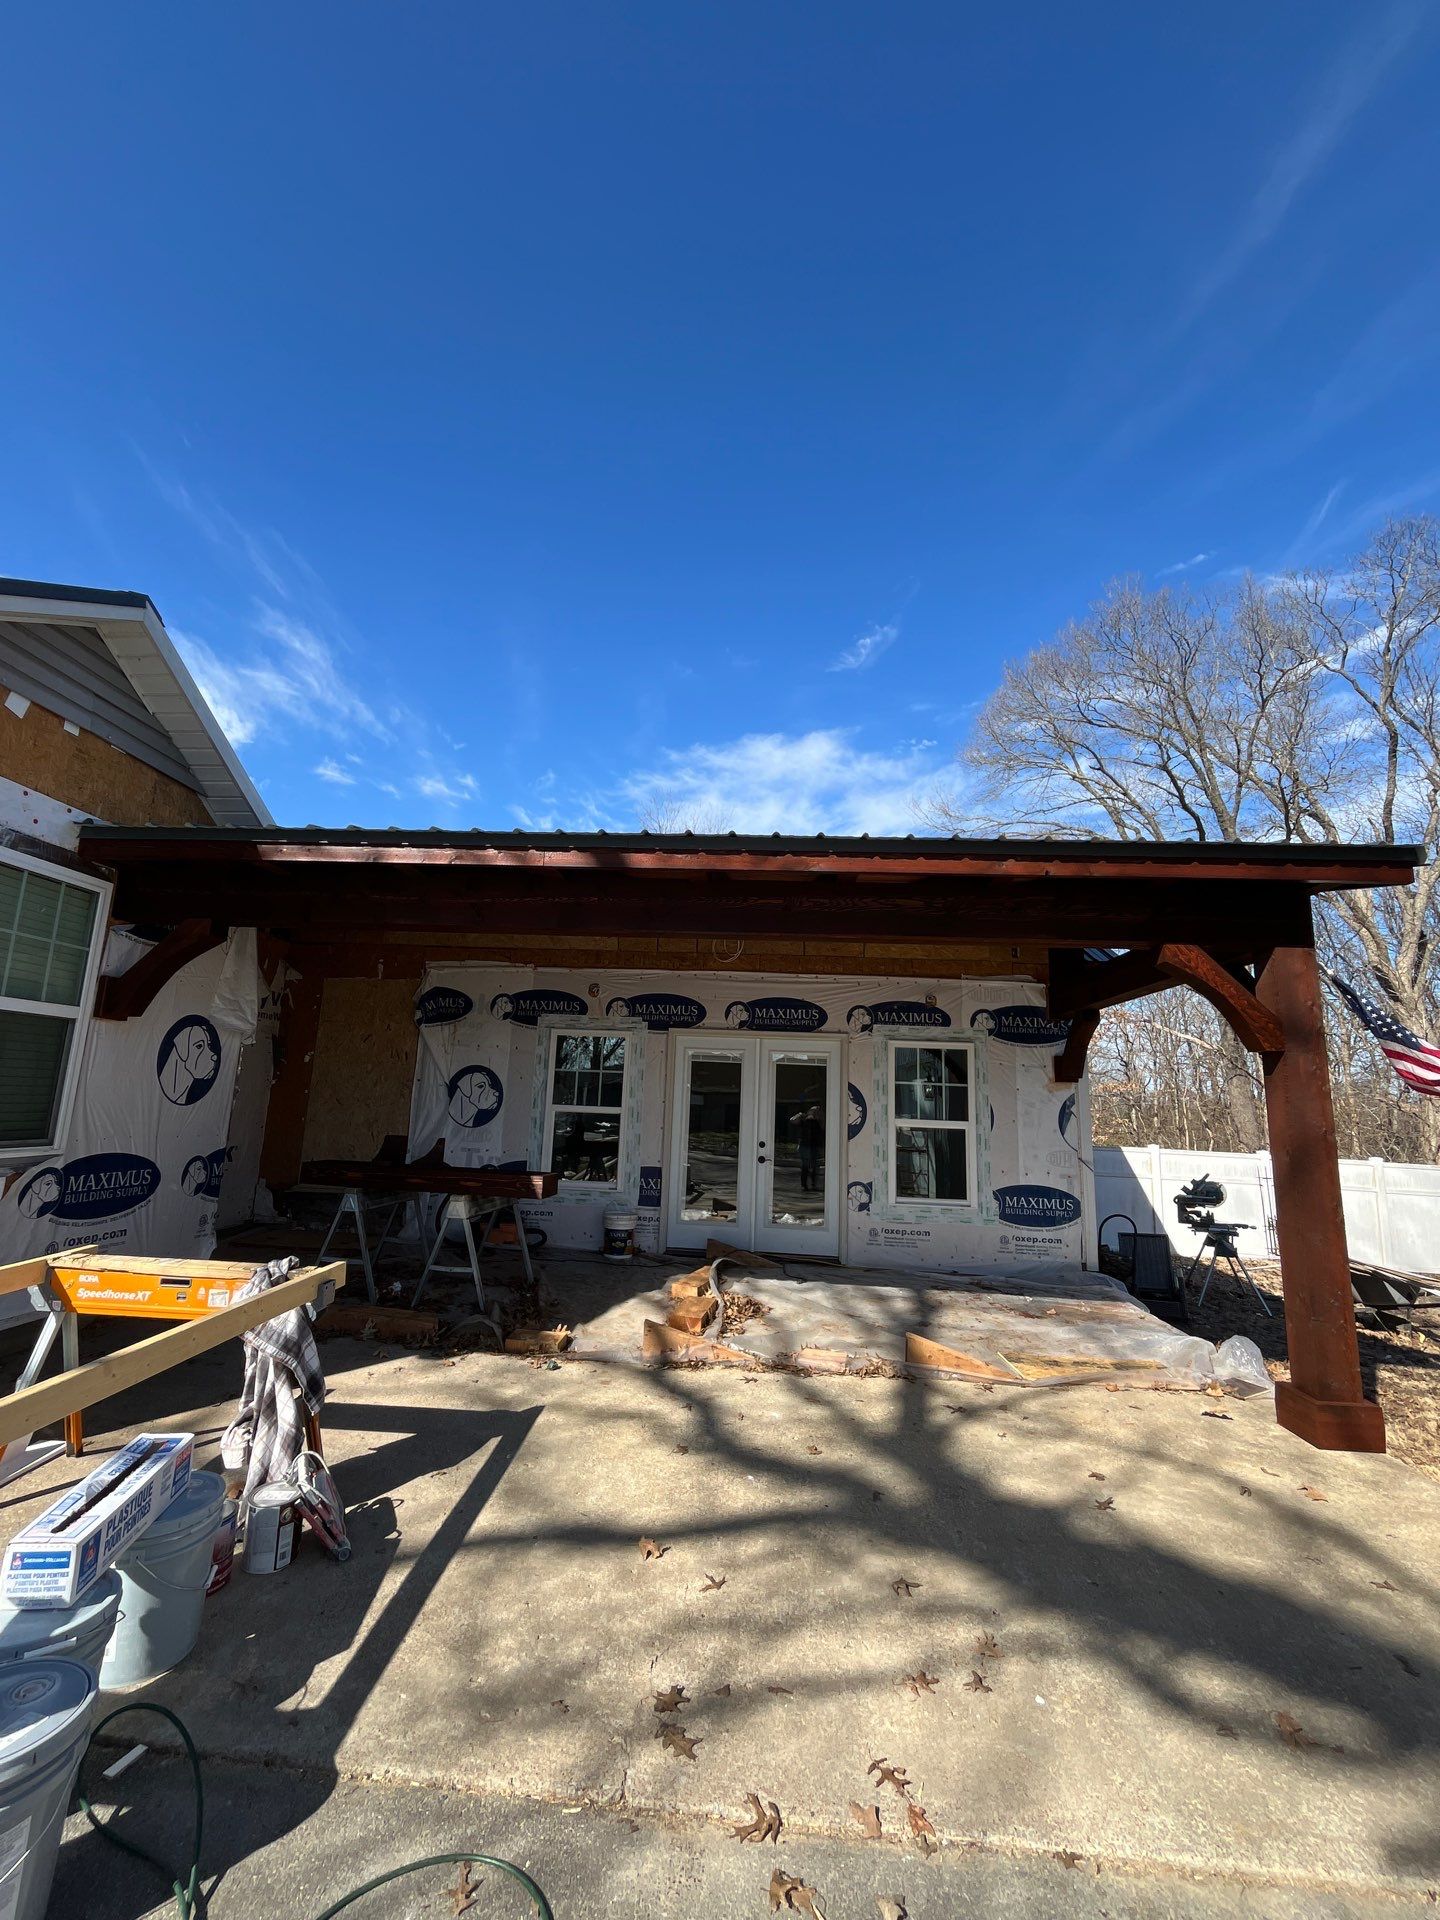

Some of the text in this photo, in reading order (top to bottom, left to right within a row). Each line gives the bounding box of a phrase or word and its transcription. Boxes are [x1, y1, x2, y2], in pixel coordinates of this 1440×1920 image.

[519, 1000, 580, 1011] MAXIMUS
[635, 1004, 698, 1015] MAXIMUS
[755, 1008, 819, 1020] MAXIMUS
[878, 1012, 942, 1023] MAXIMUS
[1001, 1026, 1038, 1034] BUILDING
[68, 1169, 152, 1193] MAXIMUS
[64, 1186, 150, 1205] BUILDING SUPPLY
[1005, 1197, 1074, 1210] MAXIMUS
[520, 1210, 553, 1218] ep.com
[1005, 1208, 1074, 1218] BUILDING SUPPLY
